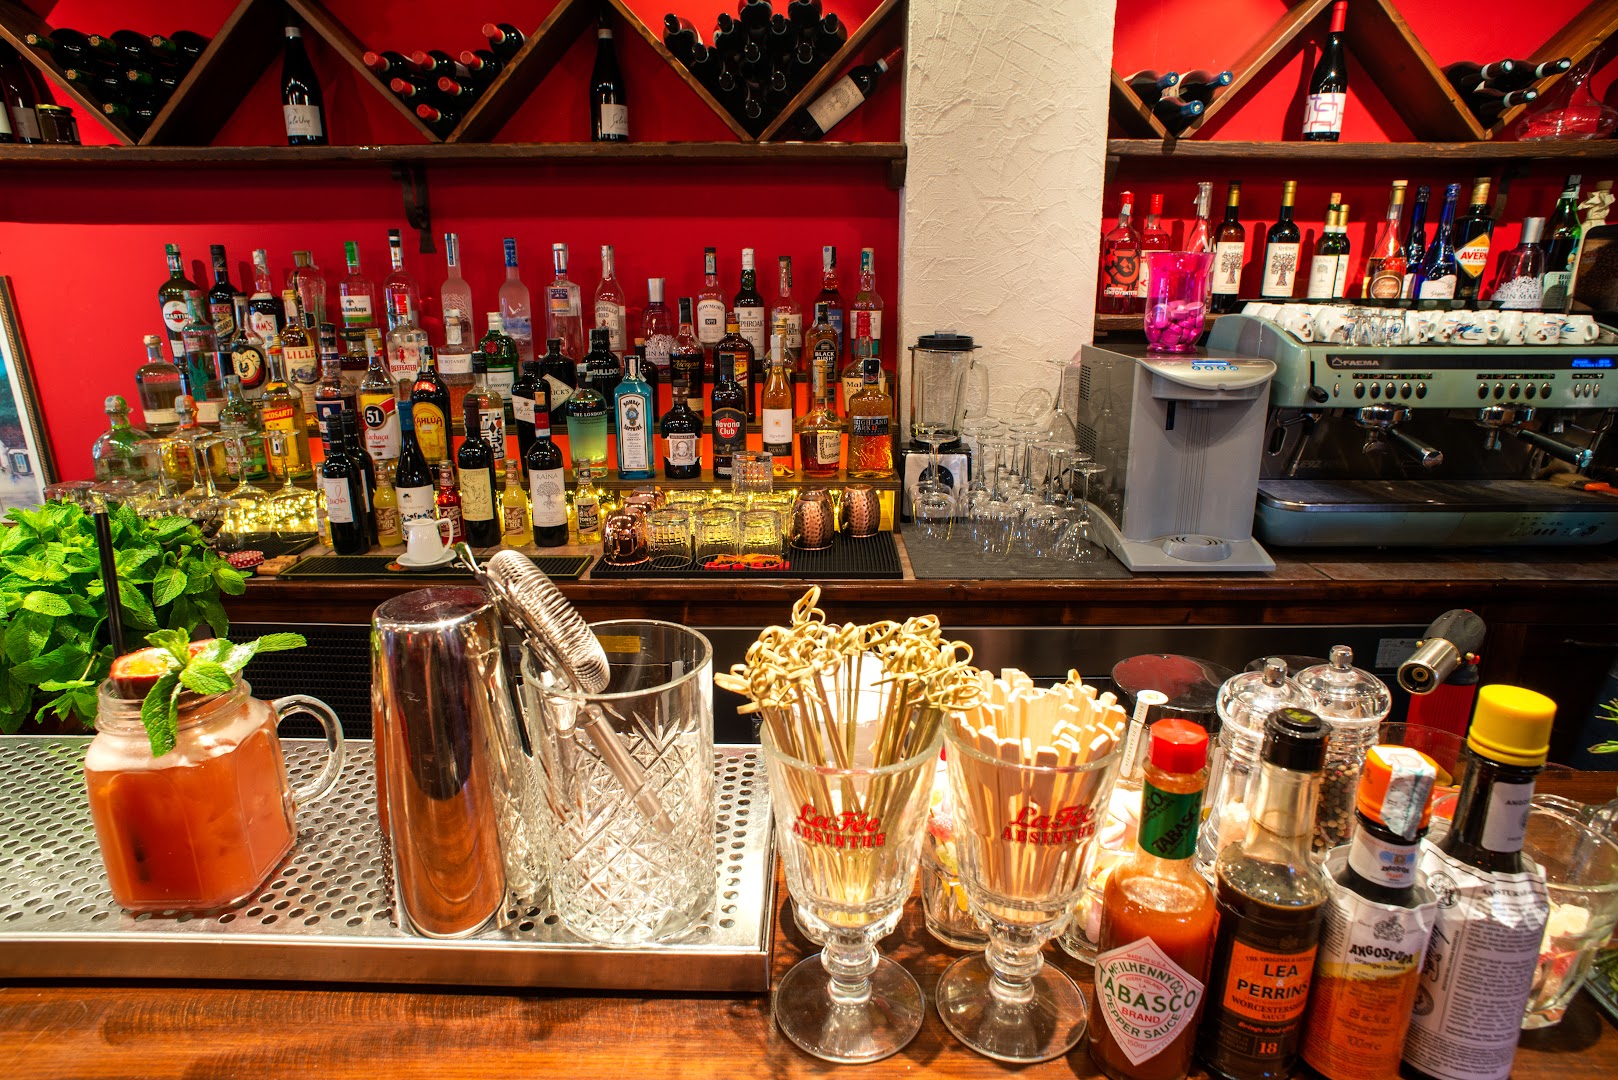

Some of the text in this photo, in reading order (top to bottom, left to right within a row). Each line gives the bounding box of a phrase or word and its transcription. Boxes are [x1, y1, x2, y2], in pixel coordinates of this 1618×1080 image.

[1460, 251, 1488, 260] AVERN
[165, 312, 189, 320] MARTIN
[286, 350, 315, 360] LILLE
[391, 364, 417, 373] BEEFEATER
[593, 368, 620, 376] BULLDO
[266, 408, 294, 420] COSARTI
[366, 409, 382, 424] 51
[797, 803, 831, 831] La
[1009, 806, 1051, 830] La
[793, 821, 886, 849] ABSINTHE
[1001, 822, 1096, 846] ABSINTHE
[1348, 943, 1414, 965] ANGOSTURA
[1263, 963, 1299, 978] LEA
[1354, 957, 1382, 969] orange
[1099, 963, 1196, 1013] TABASCO
[1236, 978, 1308, 1000] PERRINS
[1275, 979, 1284, 987] &
[1105, 993, 1140, 1038] PEPPER
[1144, 1013, 1181, 1039] SAUCE
[1121, 1006, 1161, 1024] BRAND
[1127, 1039, 1148, 1050] 150ml
[1259, 1041, 1278, 1054] 18
